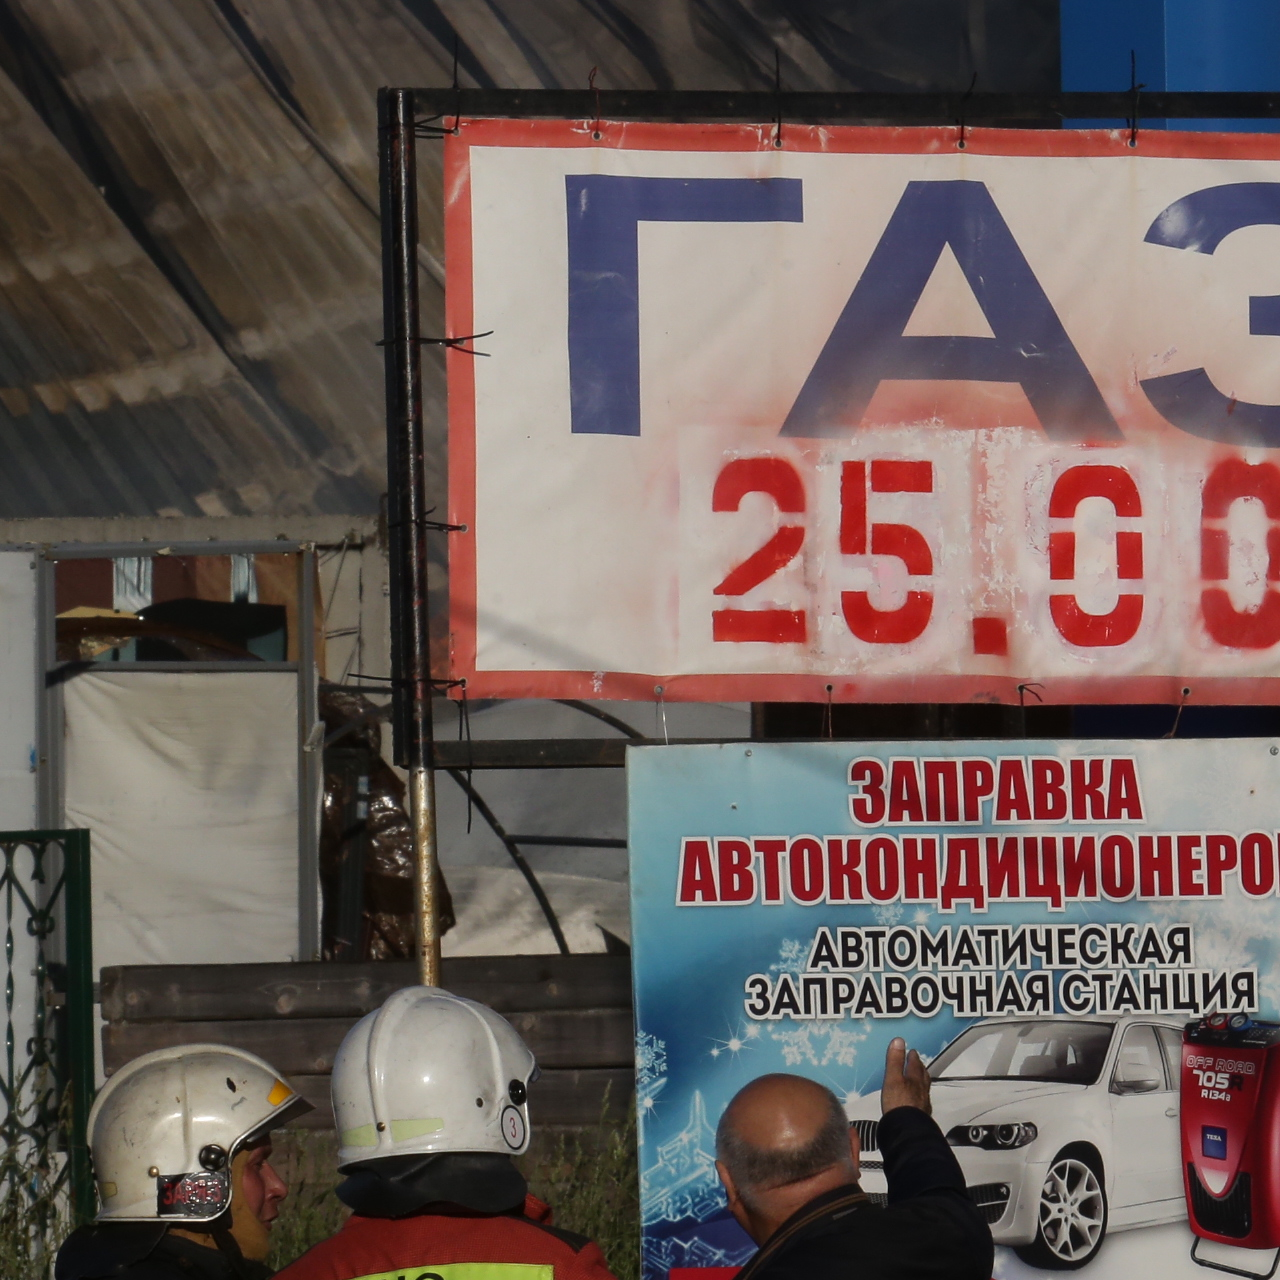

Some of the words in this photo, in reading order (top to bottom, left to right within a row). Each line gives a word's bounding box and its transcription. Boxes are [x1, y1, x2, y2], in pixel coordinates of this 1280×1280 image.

[851, 757, 1143, 824] ЗАПРАВКА
[809, 925, 1191, 971] АВТОМАТИЧЕСКАЯ
[747, 973, 1049, 1017] ЗАПРАВОЧНАЯ
[1060, 971, 1257, 1018] СТАНЦИЯ
[1186, 1055, 1214, 1068] OFF
[1215, 1058, 1256, 1075] ROAD
